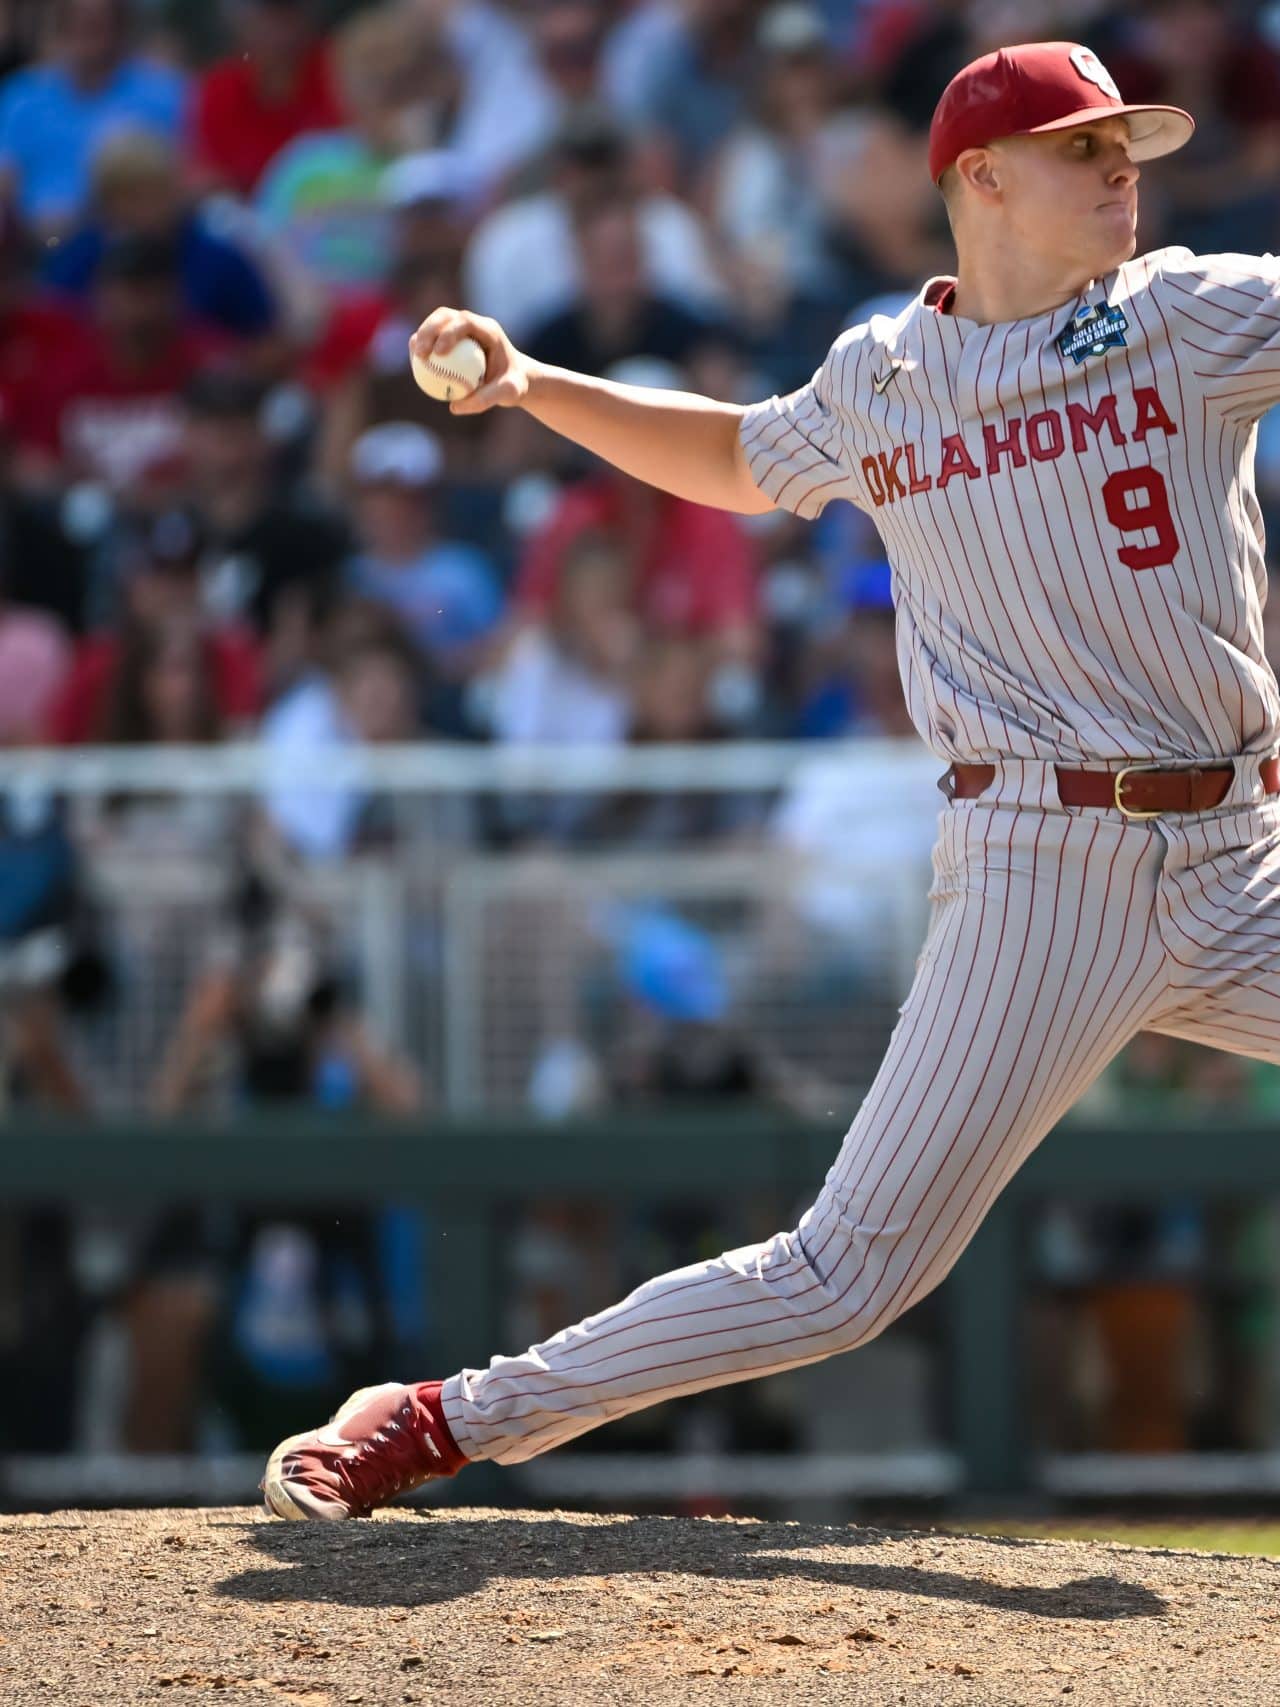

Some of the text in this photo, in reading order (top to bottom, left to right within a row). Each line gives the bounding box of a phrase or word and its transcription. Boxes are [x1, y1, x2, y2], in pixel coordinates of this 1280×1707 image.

[1064, 334, 1093, 356] WORLD
[1094, 320, 1126, 340] SERIES
[1073, 317, 1108, 342] COLLEGE
[861, 387, 1178, 508] OKLAHOMA
[1102, 465, 1180, 571] 9
